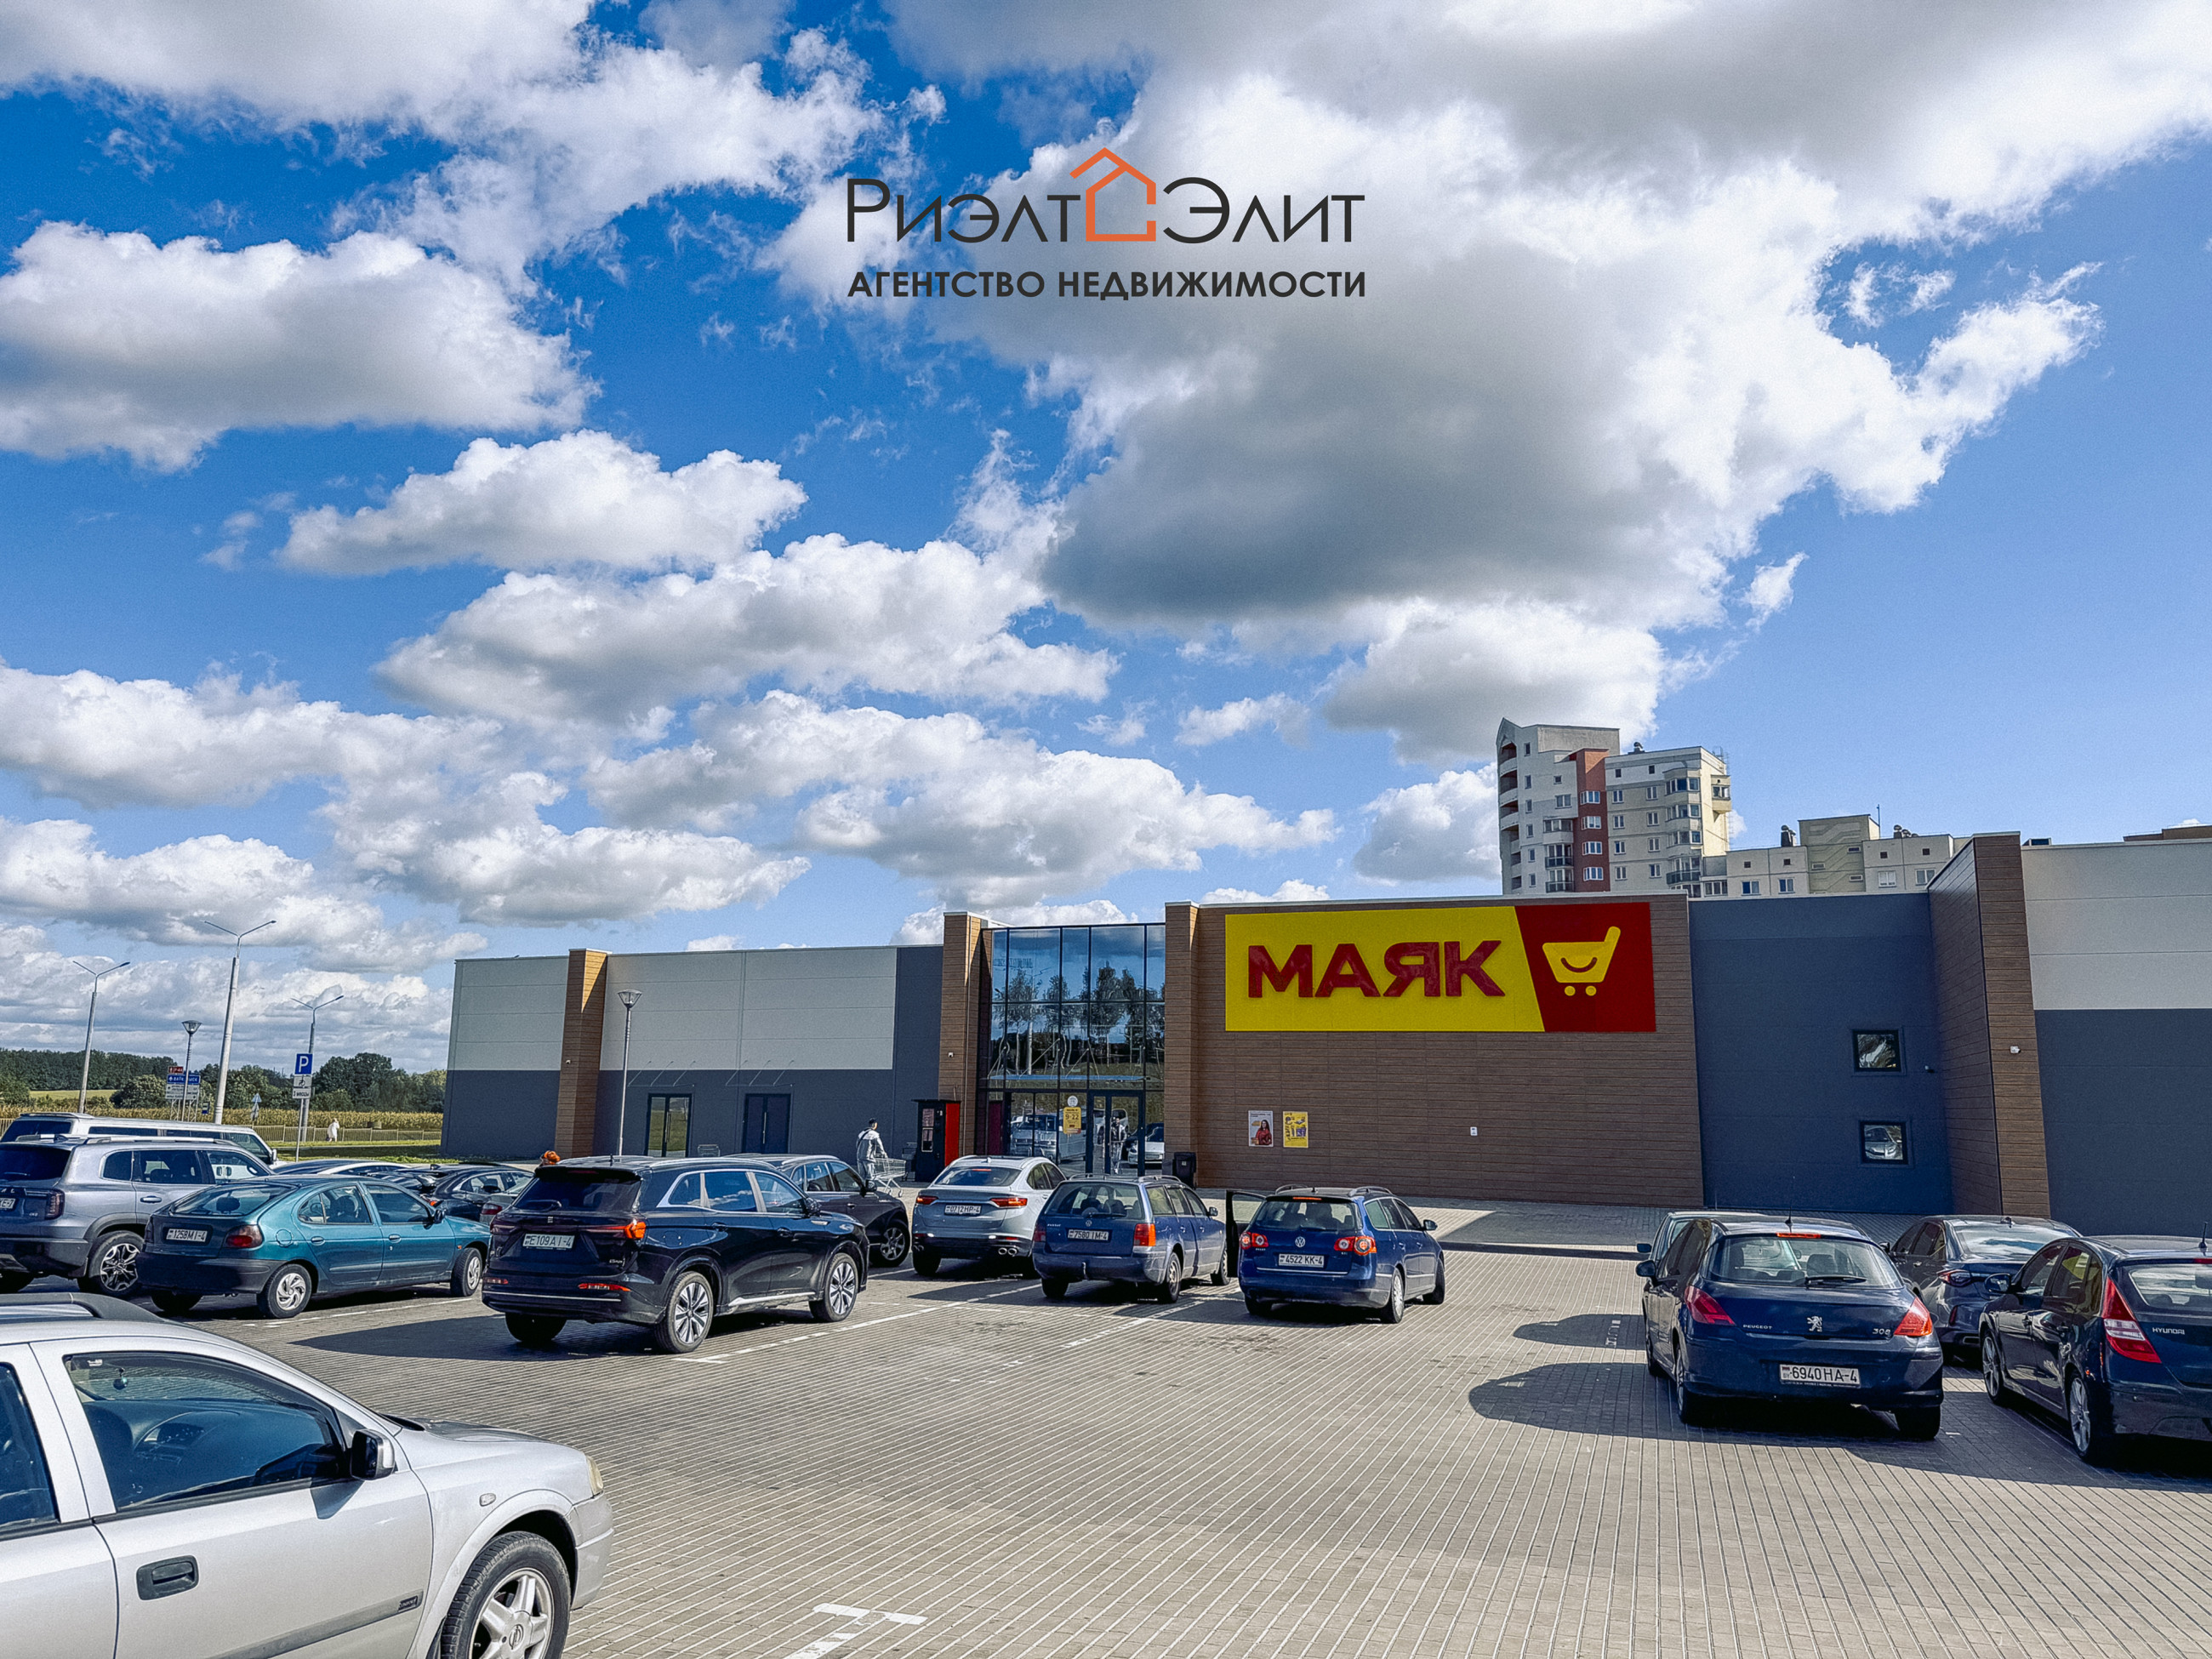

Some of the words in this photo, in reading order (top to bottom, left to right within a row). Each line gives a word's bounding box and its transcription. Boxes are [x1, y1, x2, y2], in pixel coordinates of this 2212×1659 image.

[1247, 939, 1507, 998] МАЯК
[299, 1056, 309, 1073] P
[1872, 1327, 1891, 1336] 308
